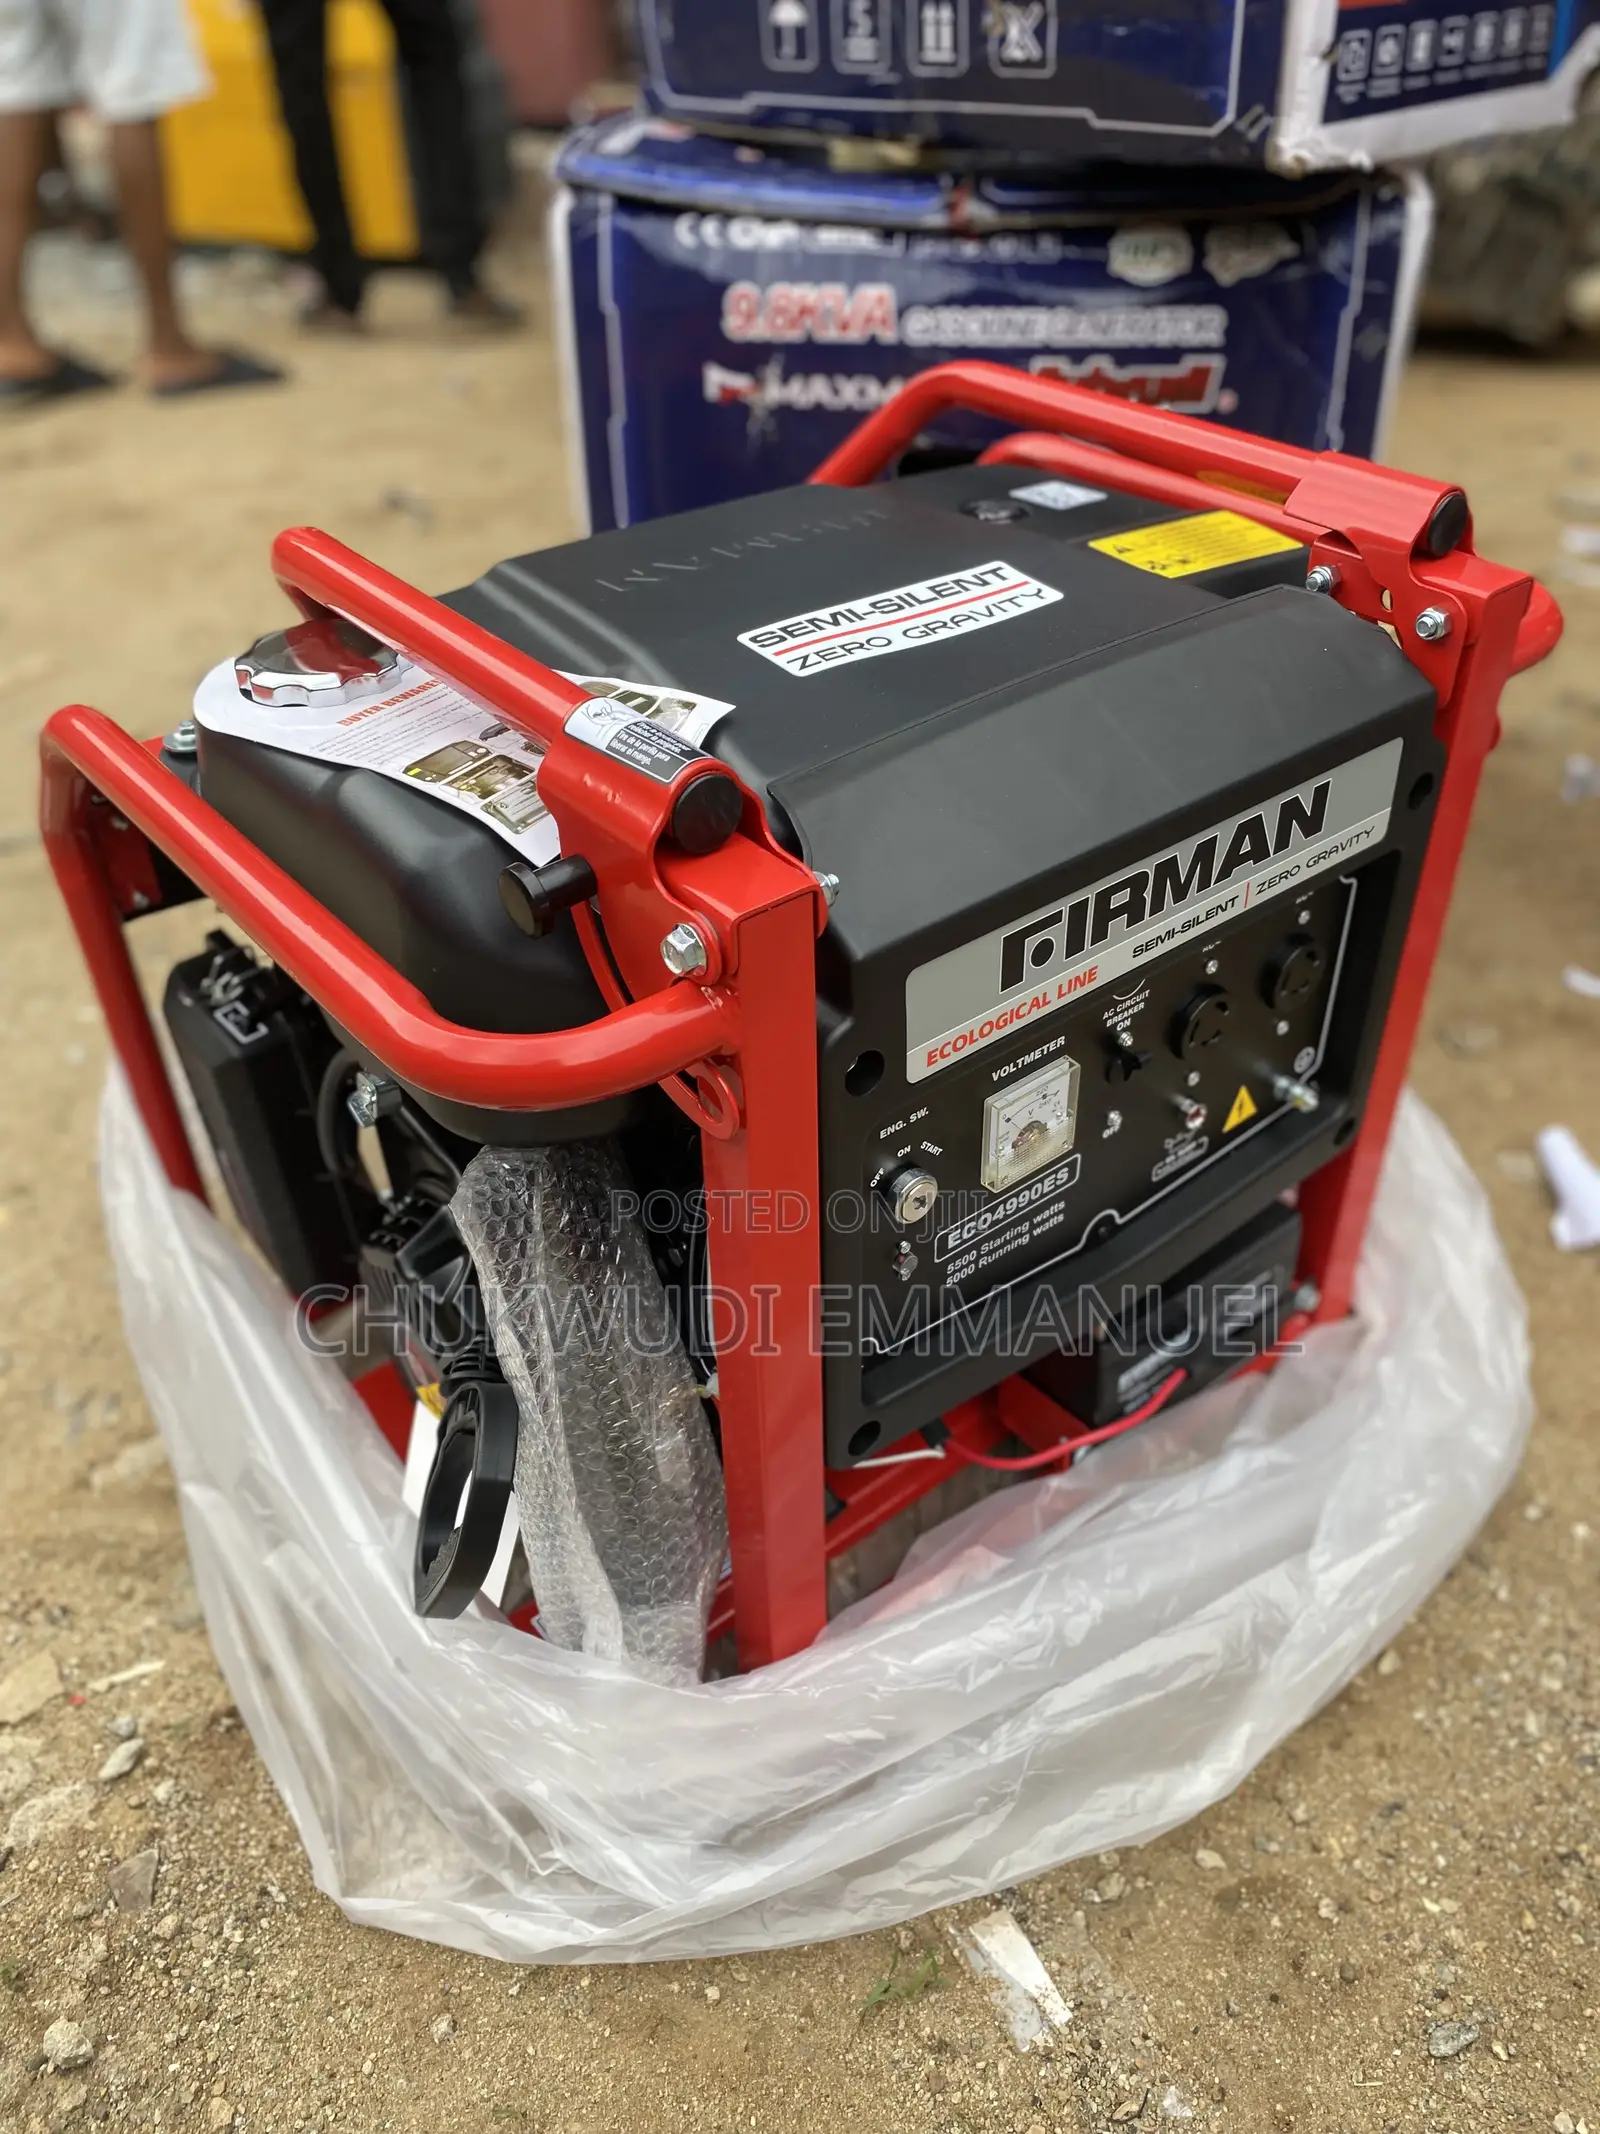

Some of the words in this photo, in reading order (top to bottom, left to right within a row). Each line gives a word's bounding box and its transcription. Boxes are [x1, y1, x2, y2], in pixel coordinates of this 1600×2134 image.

[748, 566, 1012, 648] SEMI-SILENT
[786, 636, 892, 671] ZERO
[902, 588, 1047, 639] GRAVITY
[336, 705, 385, 726] BUYER
[626, 736, 636, 744] de
[634, 739, 641, 748] la
[654, 751, 671, 762] para
[626, 748, 634, 756] el
[999, 778, 1332, 993] FIRMAN
[1132, 895, 1239, 958] SEMI-SILENT
[1255, 865, 1301, 896] ZERO
[1306, 826, 1376, 869] GRAVITY
[926, 992, 1052, 1067] ECOLOGICAL
[1057, 965, 1099, 1000] LINE
[1103, 1008, 1115, 1020] AC
[1116, 989, 1150, 1012] CIRCUIT
[1106, 1002, 1145, 1027] BREAKER
[1117, 1018, 1131, 1031] ON
[992, 1036, 1066, 1081] VOLTMETER
[880, 1120, 907, 1139] ENG.
[909, 1107, 929, 1123] SW.
[897, 1145, 911, 1157] ON
[920, 1141, 943, 1156] START
[870, 1167, 884, 1187] OFF
[948, 1167, 1069, 1249] ECO4990ES
[946, 1250, 977, 1274] 5500
[980, 1221, 1030, 1255] Starting
[1032, 1200, 1066, 1224] watts
[946, 1264, 975, 1287] 5000
[978, 1233, 1030, 1268] Running
[1032, 1213, 1065, 1237] watts
